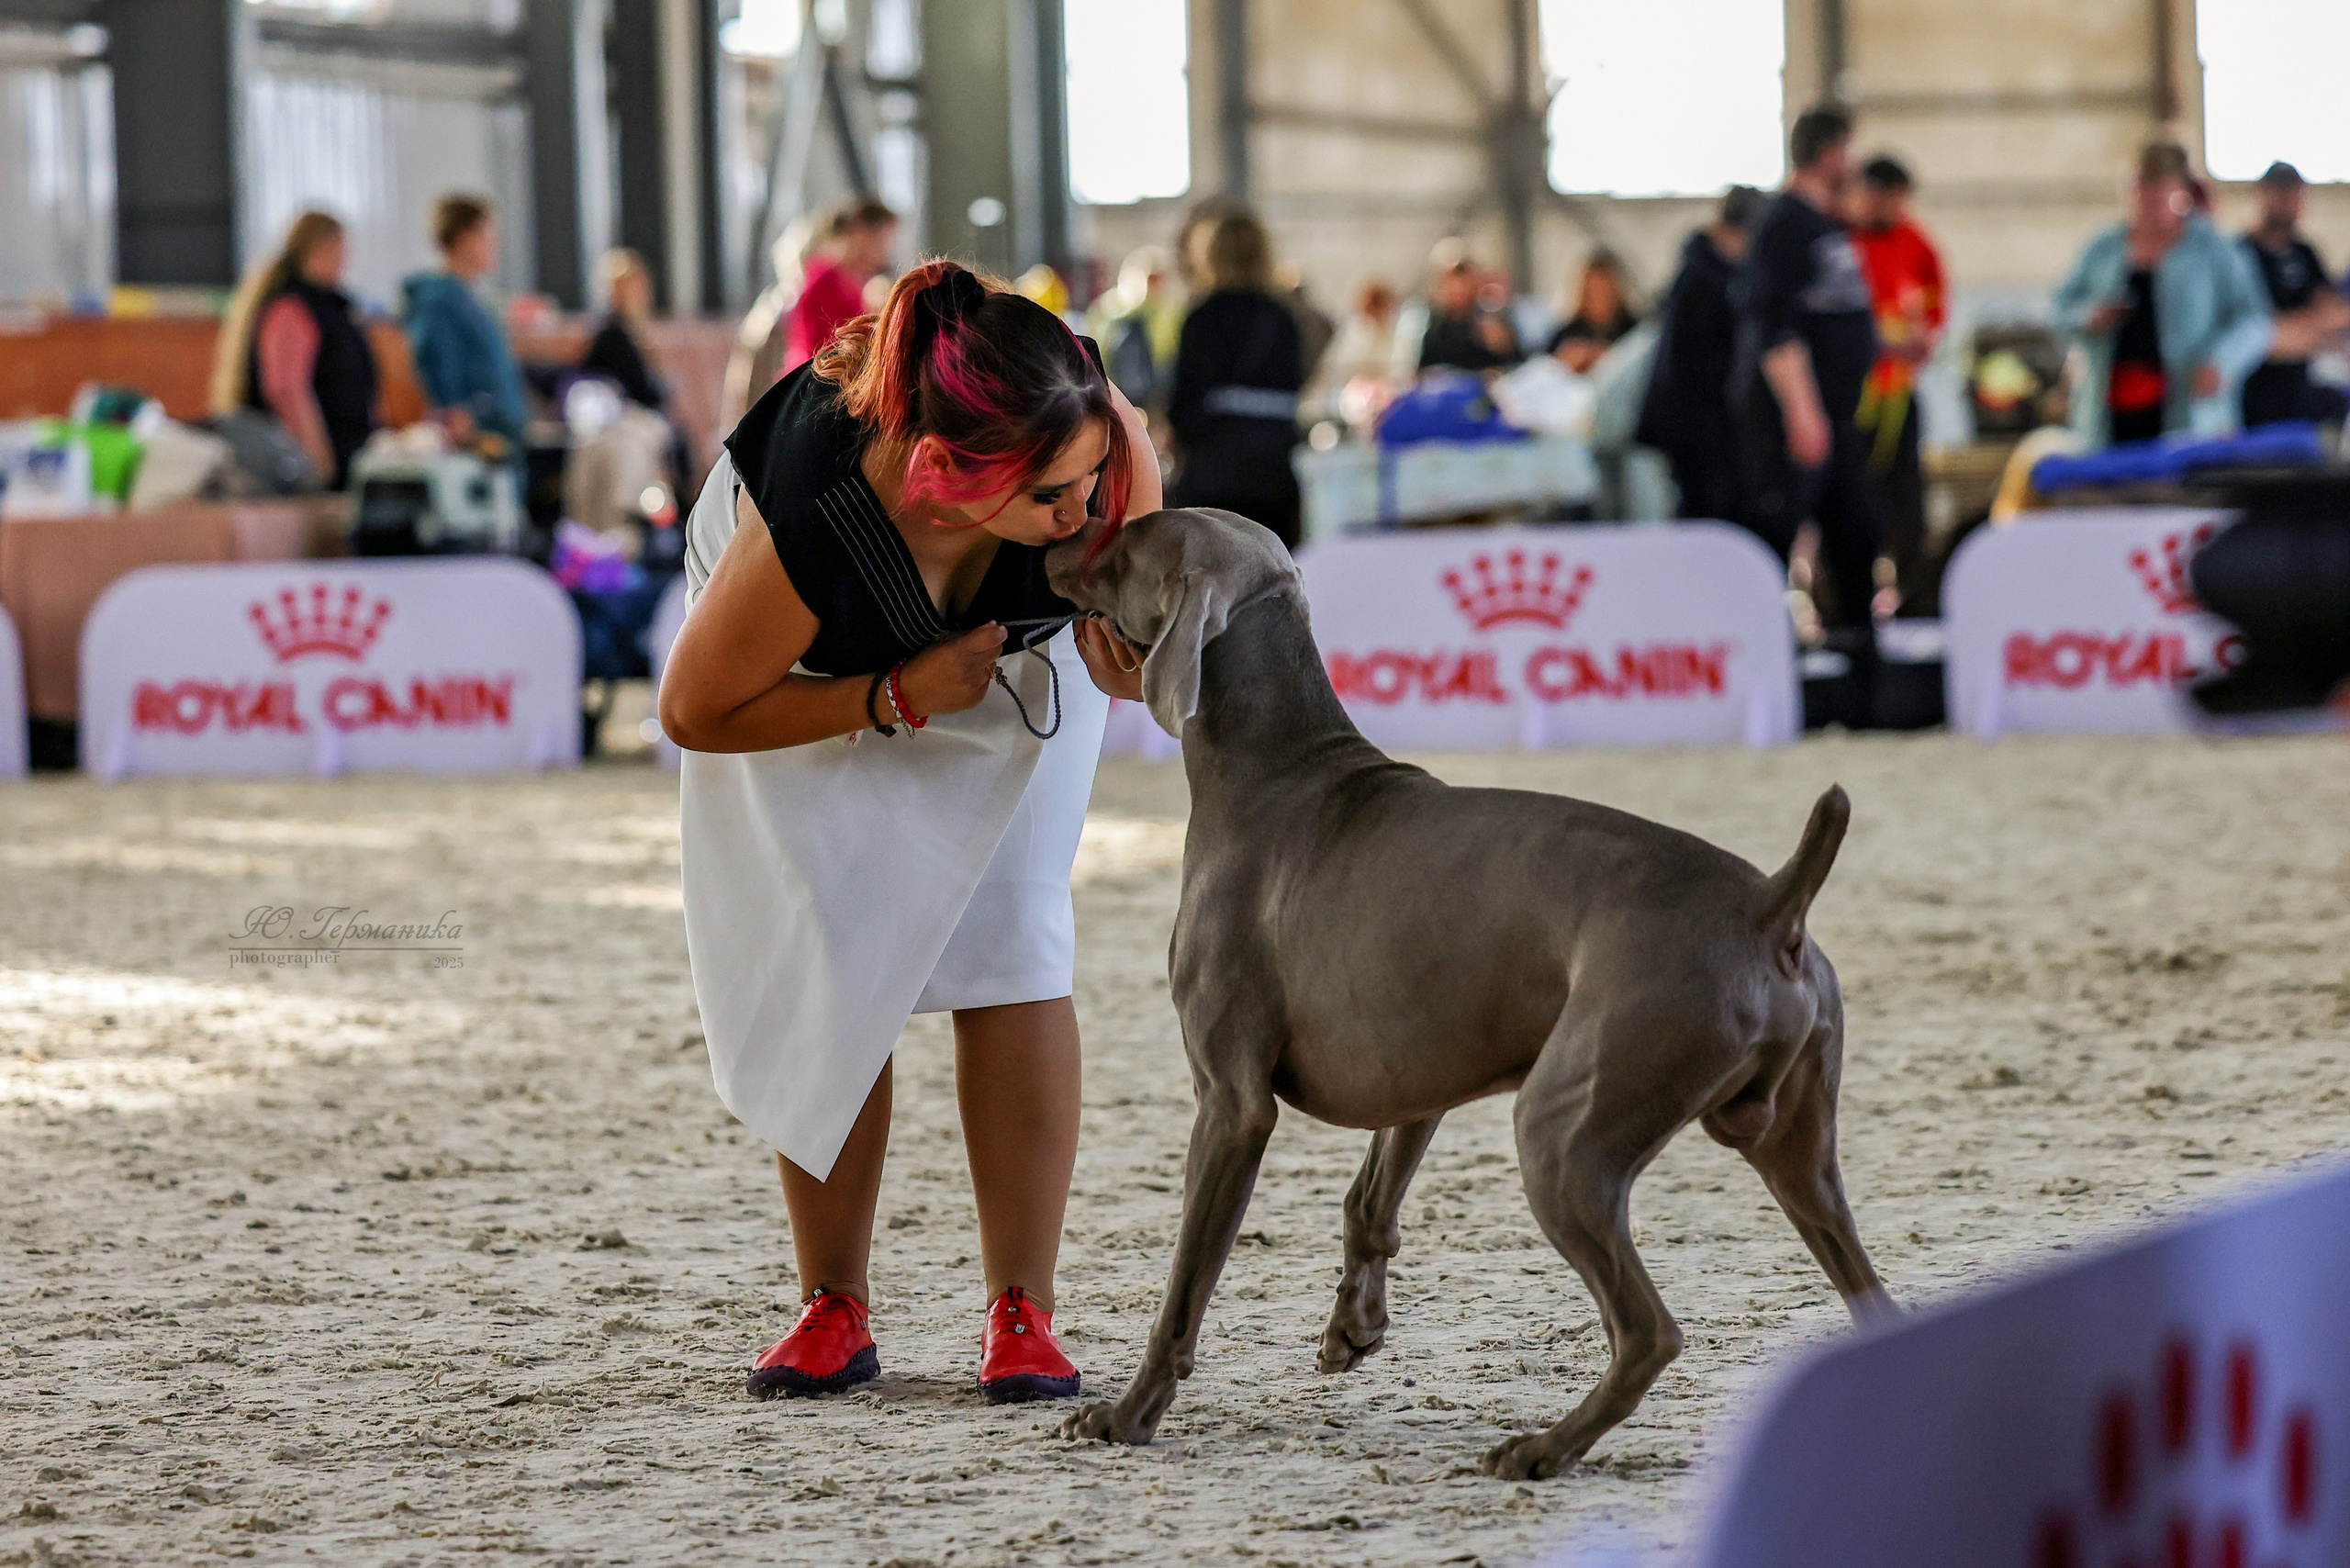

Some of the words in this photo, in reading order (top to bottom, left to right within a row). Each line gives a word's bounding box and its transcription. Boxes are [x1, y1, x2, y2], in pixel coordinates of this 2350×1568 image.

[1327, 650, 1505, 705] ROYAL
[1524, 643, 1728, 701] CANIN
[2005, 632, 2198, 689] ROYAL
[131, 679, 304, 734] ROYAL
[322, 677, 513, 733] CANIN
